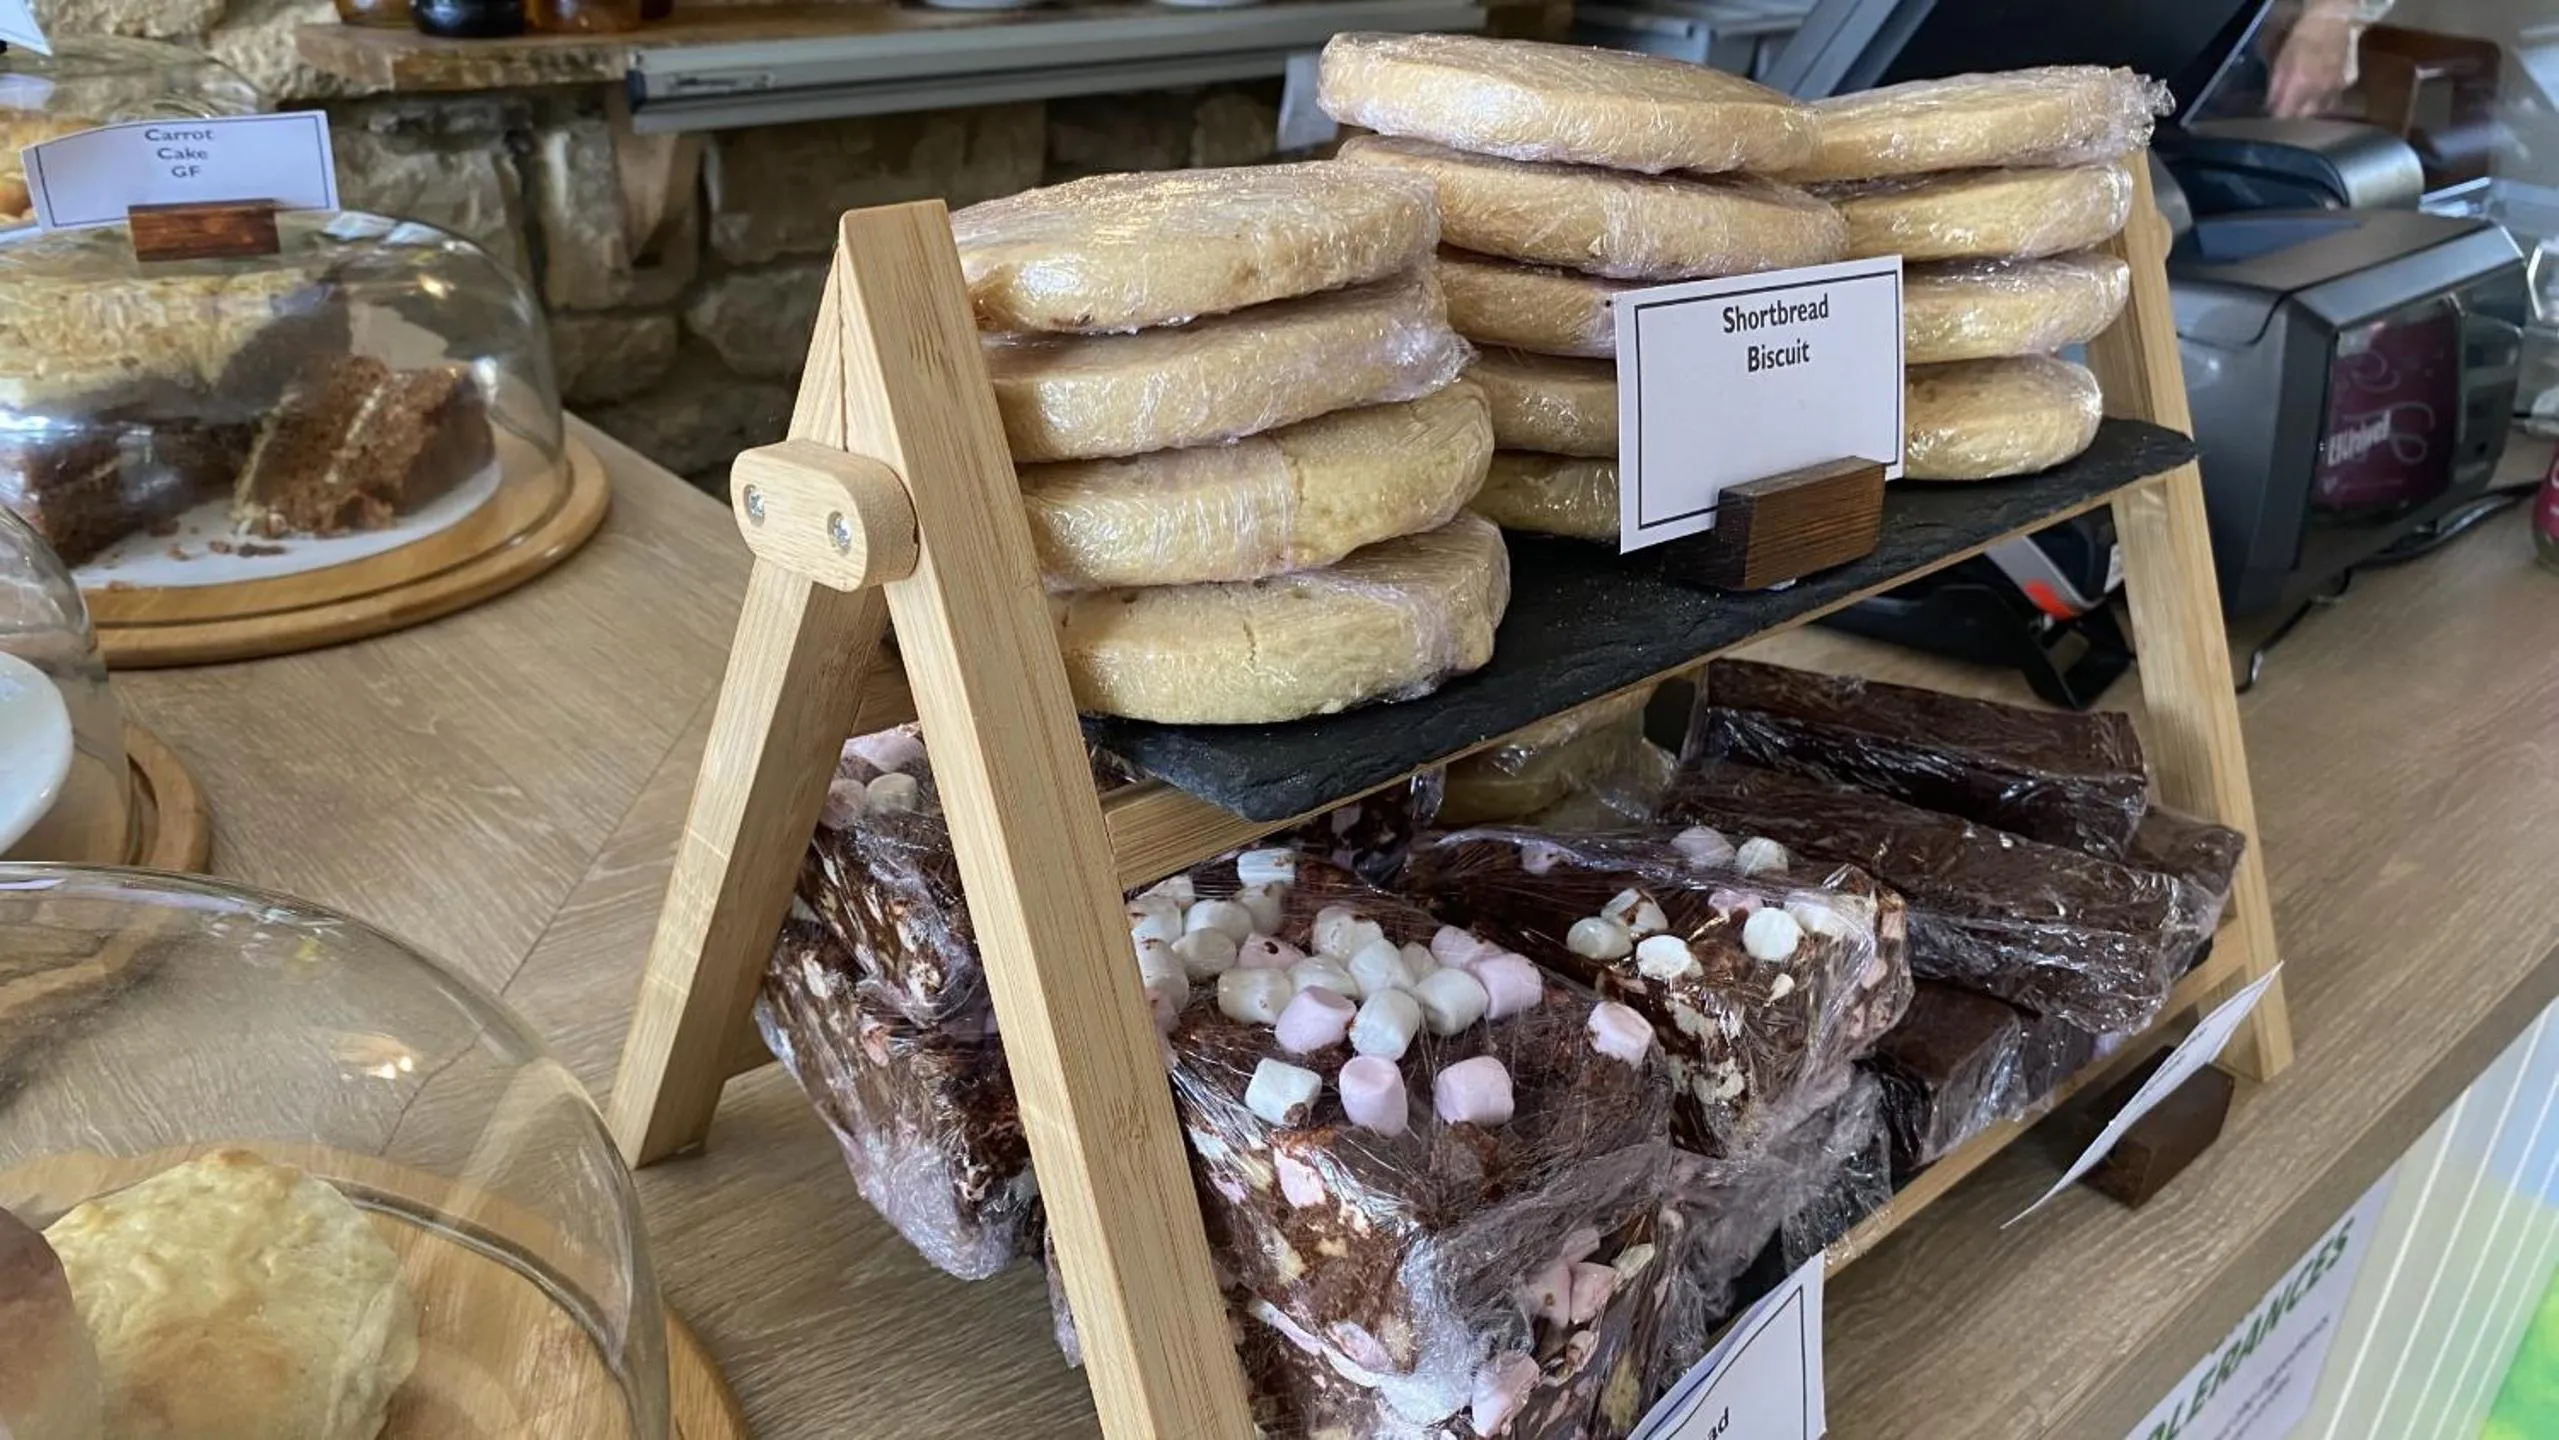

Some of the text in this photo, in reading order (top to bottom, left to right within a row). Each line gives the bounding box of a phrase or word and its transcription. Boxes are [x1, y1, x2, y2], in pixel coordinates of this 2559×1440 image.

[144, 128, 215, 142] Carrot
[156, 146, 208, 160] Cake
[171, 164, 200, 177] GF
[1722, 292, 1829, 333] Shortbread
[1747, 338, 1810, 372] Biscuit
